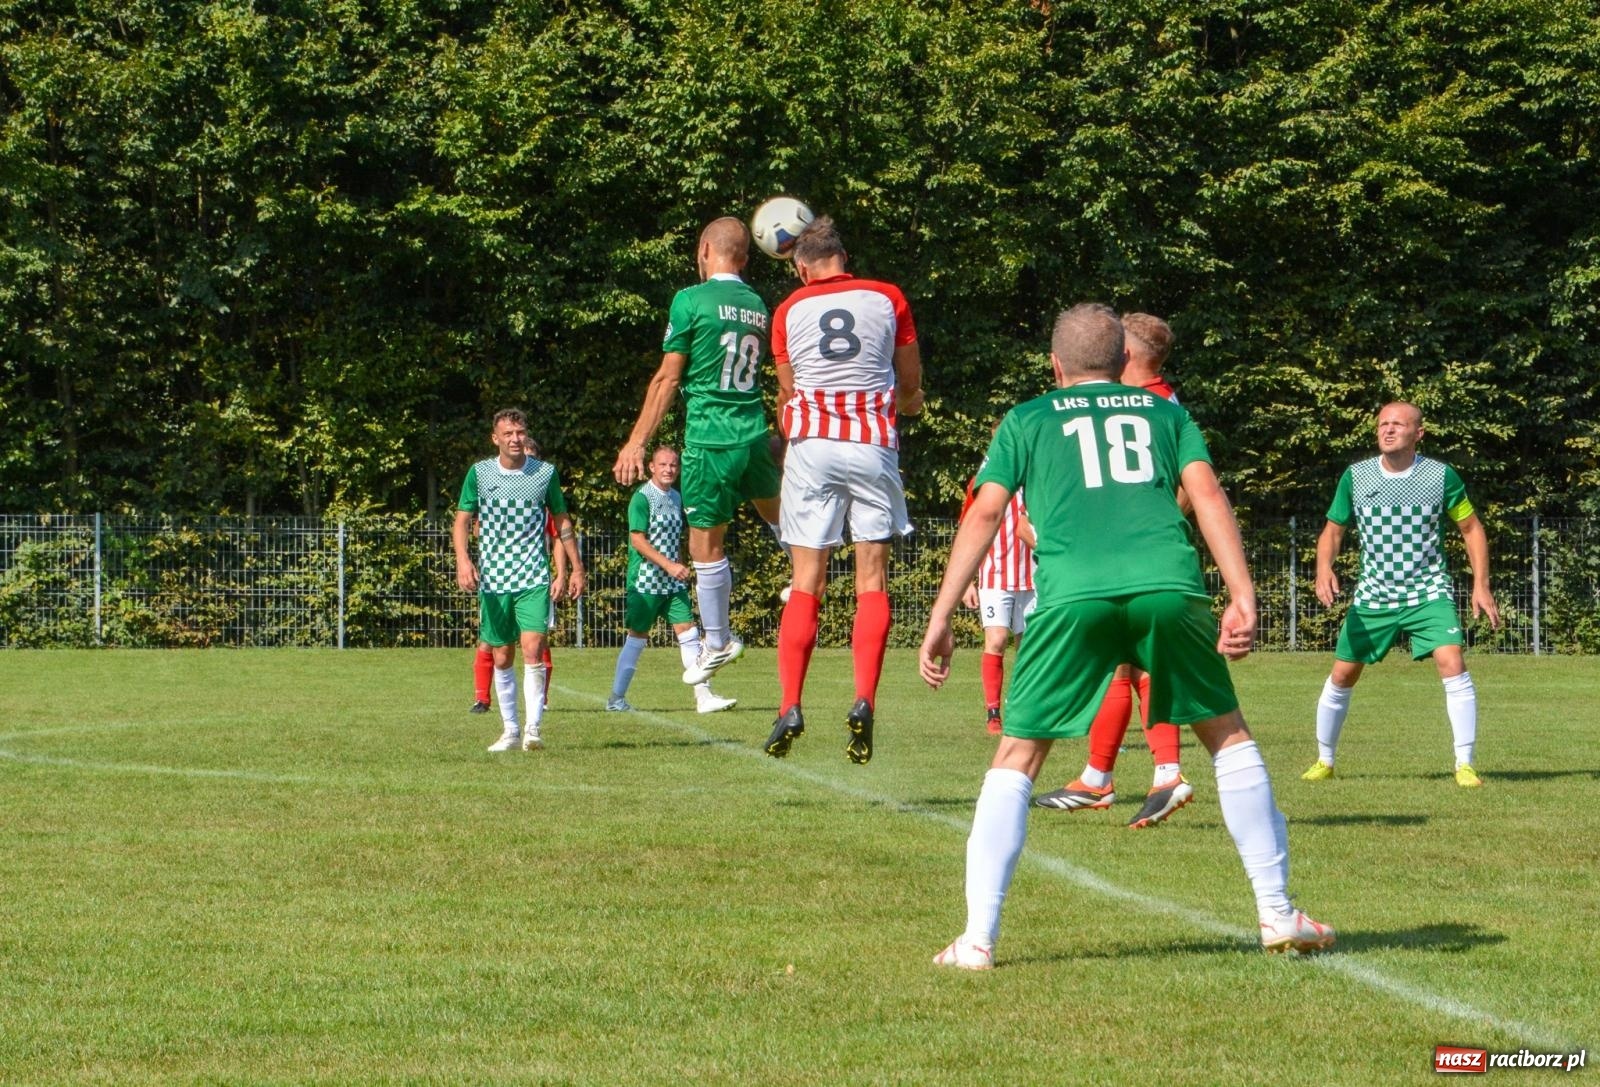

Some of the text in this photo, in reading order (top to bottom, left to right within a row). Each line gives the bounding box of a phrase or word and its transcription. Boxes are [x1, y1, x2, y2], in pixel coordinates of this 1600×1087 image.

[719, 305, 737, 321] LKS
[818, 308, 861, 361] 8
[720, 331, 759, 392] 10
[1052, 395, 1154, 411] LKS OCICE
[1062, 414, 1154, 489] 18
[986, 605, 995, 618] 3
